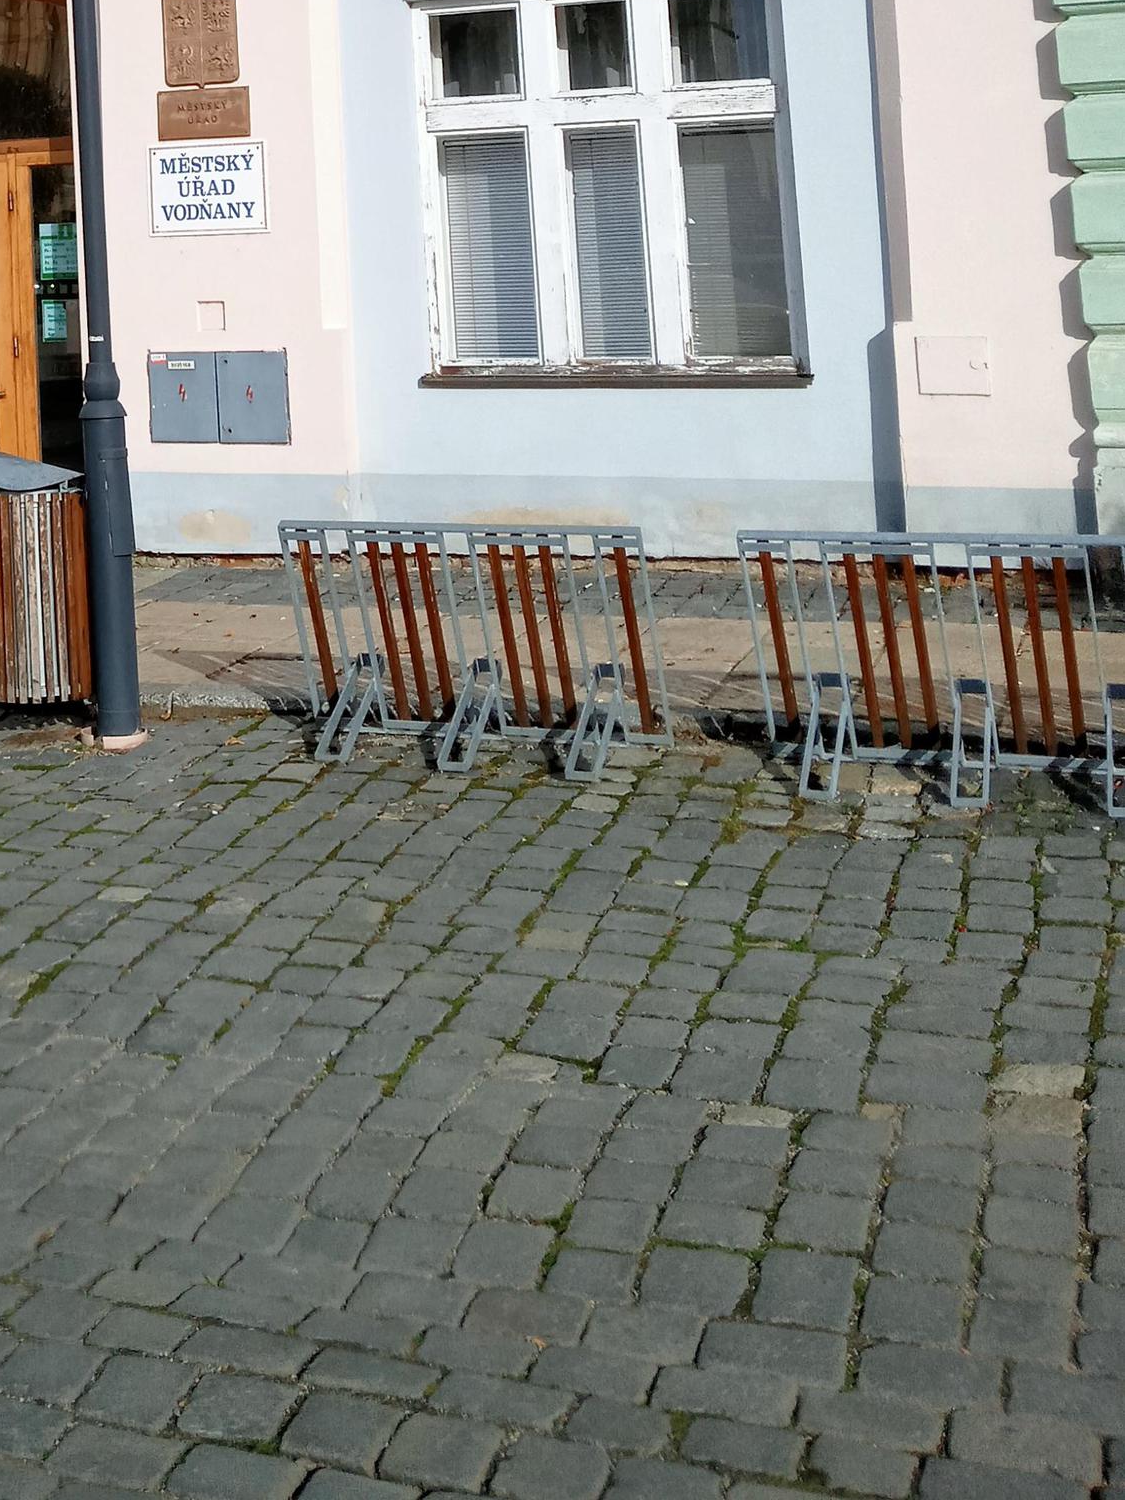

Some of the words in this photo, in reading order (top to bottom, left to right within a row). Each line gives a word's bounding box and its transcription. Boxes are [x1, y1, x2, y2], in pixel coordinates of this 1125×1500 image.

[159, 149, 254, 175] MĚSTSKÝ
[177, 176, 236, 197] ÚŘAD
[161, 198, 255, 221] VODŇANY
